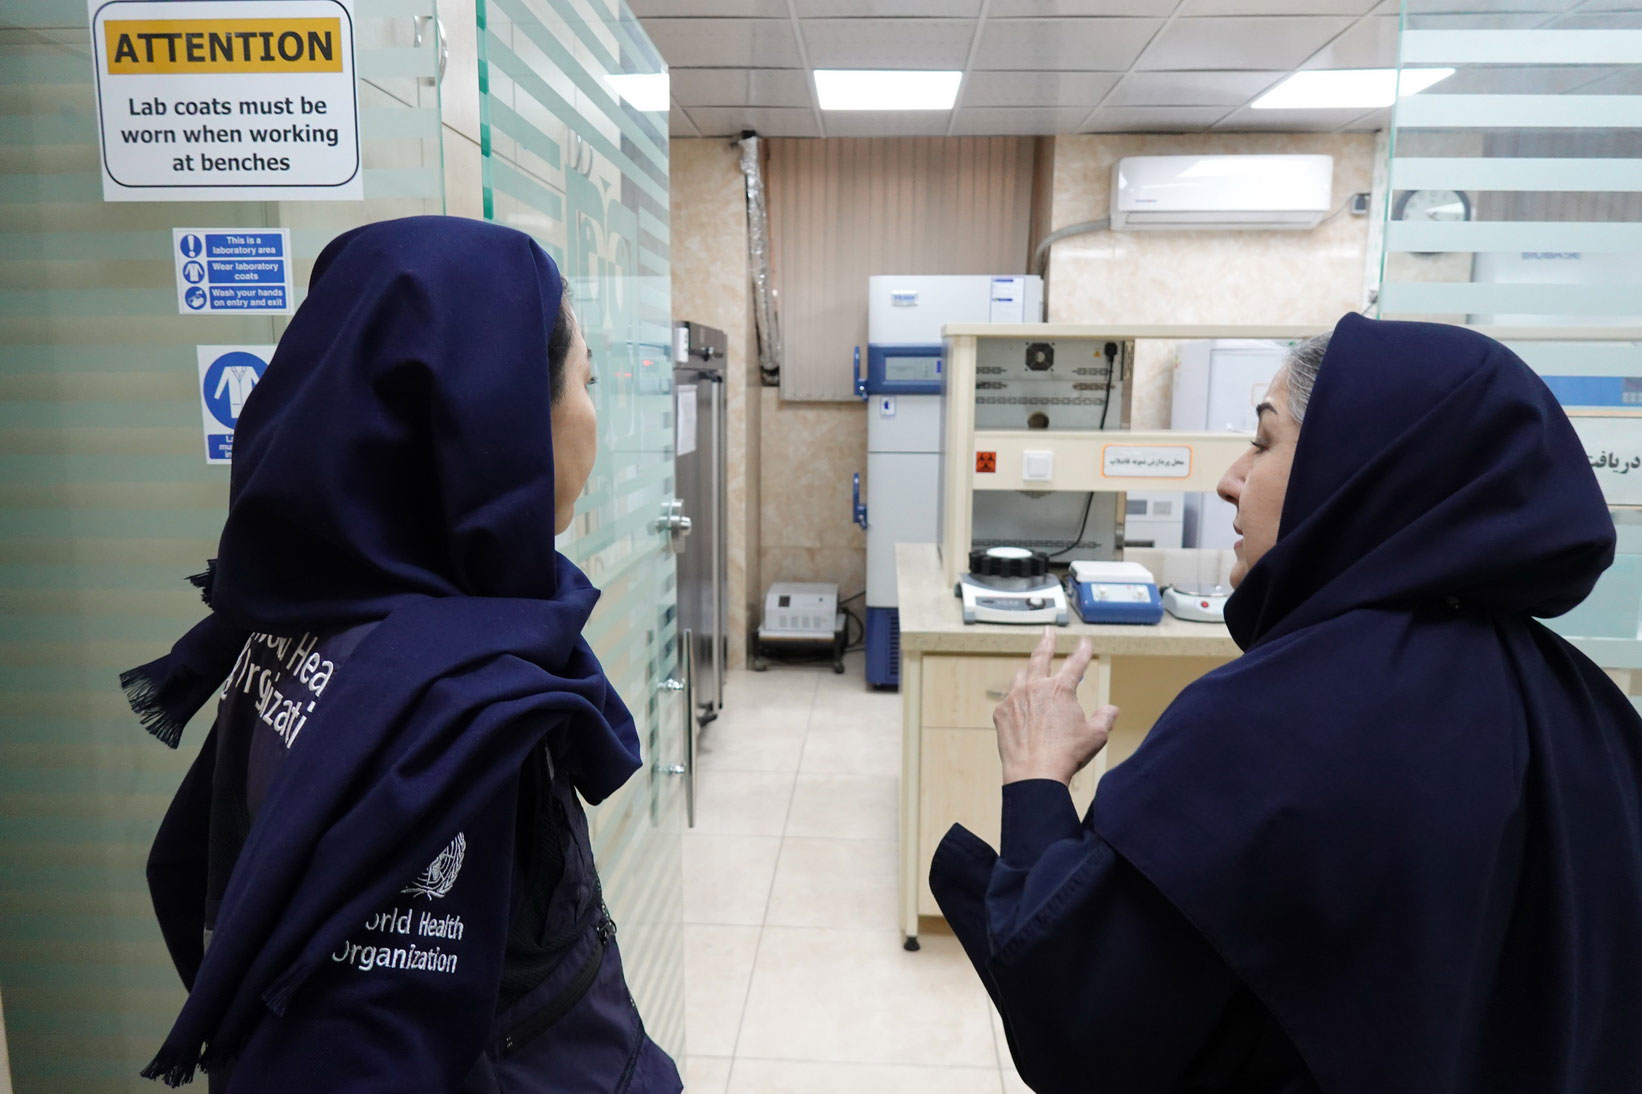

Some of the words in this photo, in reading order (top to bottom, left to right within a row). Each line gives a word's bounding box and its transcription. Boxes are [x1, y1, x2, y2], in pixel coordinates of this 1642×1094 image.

[114, 31, 333, 63] ATTENTION
[129, 98, 167, 116] Lab
[174, 99, 231, 115] coats
[239, 98, 294, 115] must
[300, 96, 327, 115] be
[121, 128, 176, 144] worn
[183, 125, 242, 143] when
[249, 124, 339, 146] working
[172, 155, 195, 171] at
[201, 153, 290, 171] benches
[226, 236, 245, 245] This
[246, 236, 255, 245] is
[212, 246, 256, 255] laboratory
[212, 262, 233, 271] Wear
[235, 262, 279, 271] laboratory
[234, 272, 259, 280] coats
[211, 289, 235, 297] Wash
[237, 290, 256, 299] your
[257, 288, 283, 297] hands
[226, 299, 248, 308] entry
[250, 298, 266, 306] and
[267, 298, 283, 306] exit
[418, 911, 464, 940] Health
